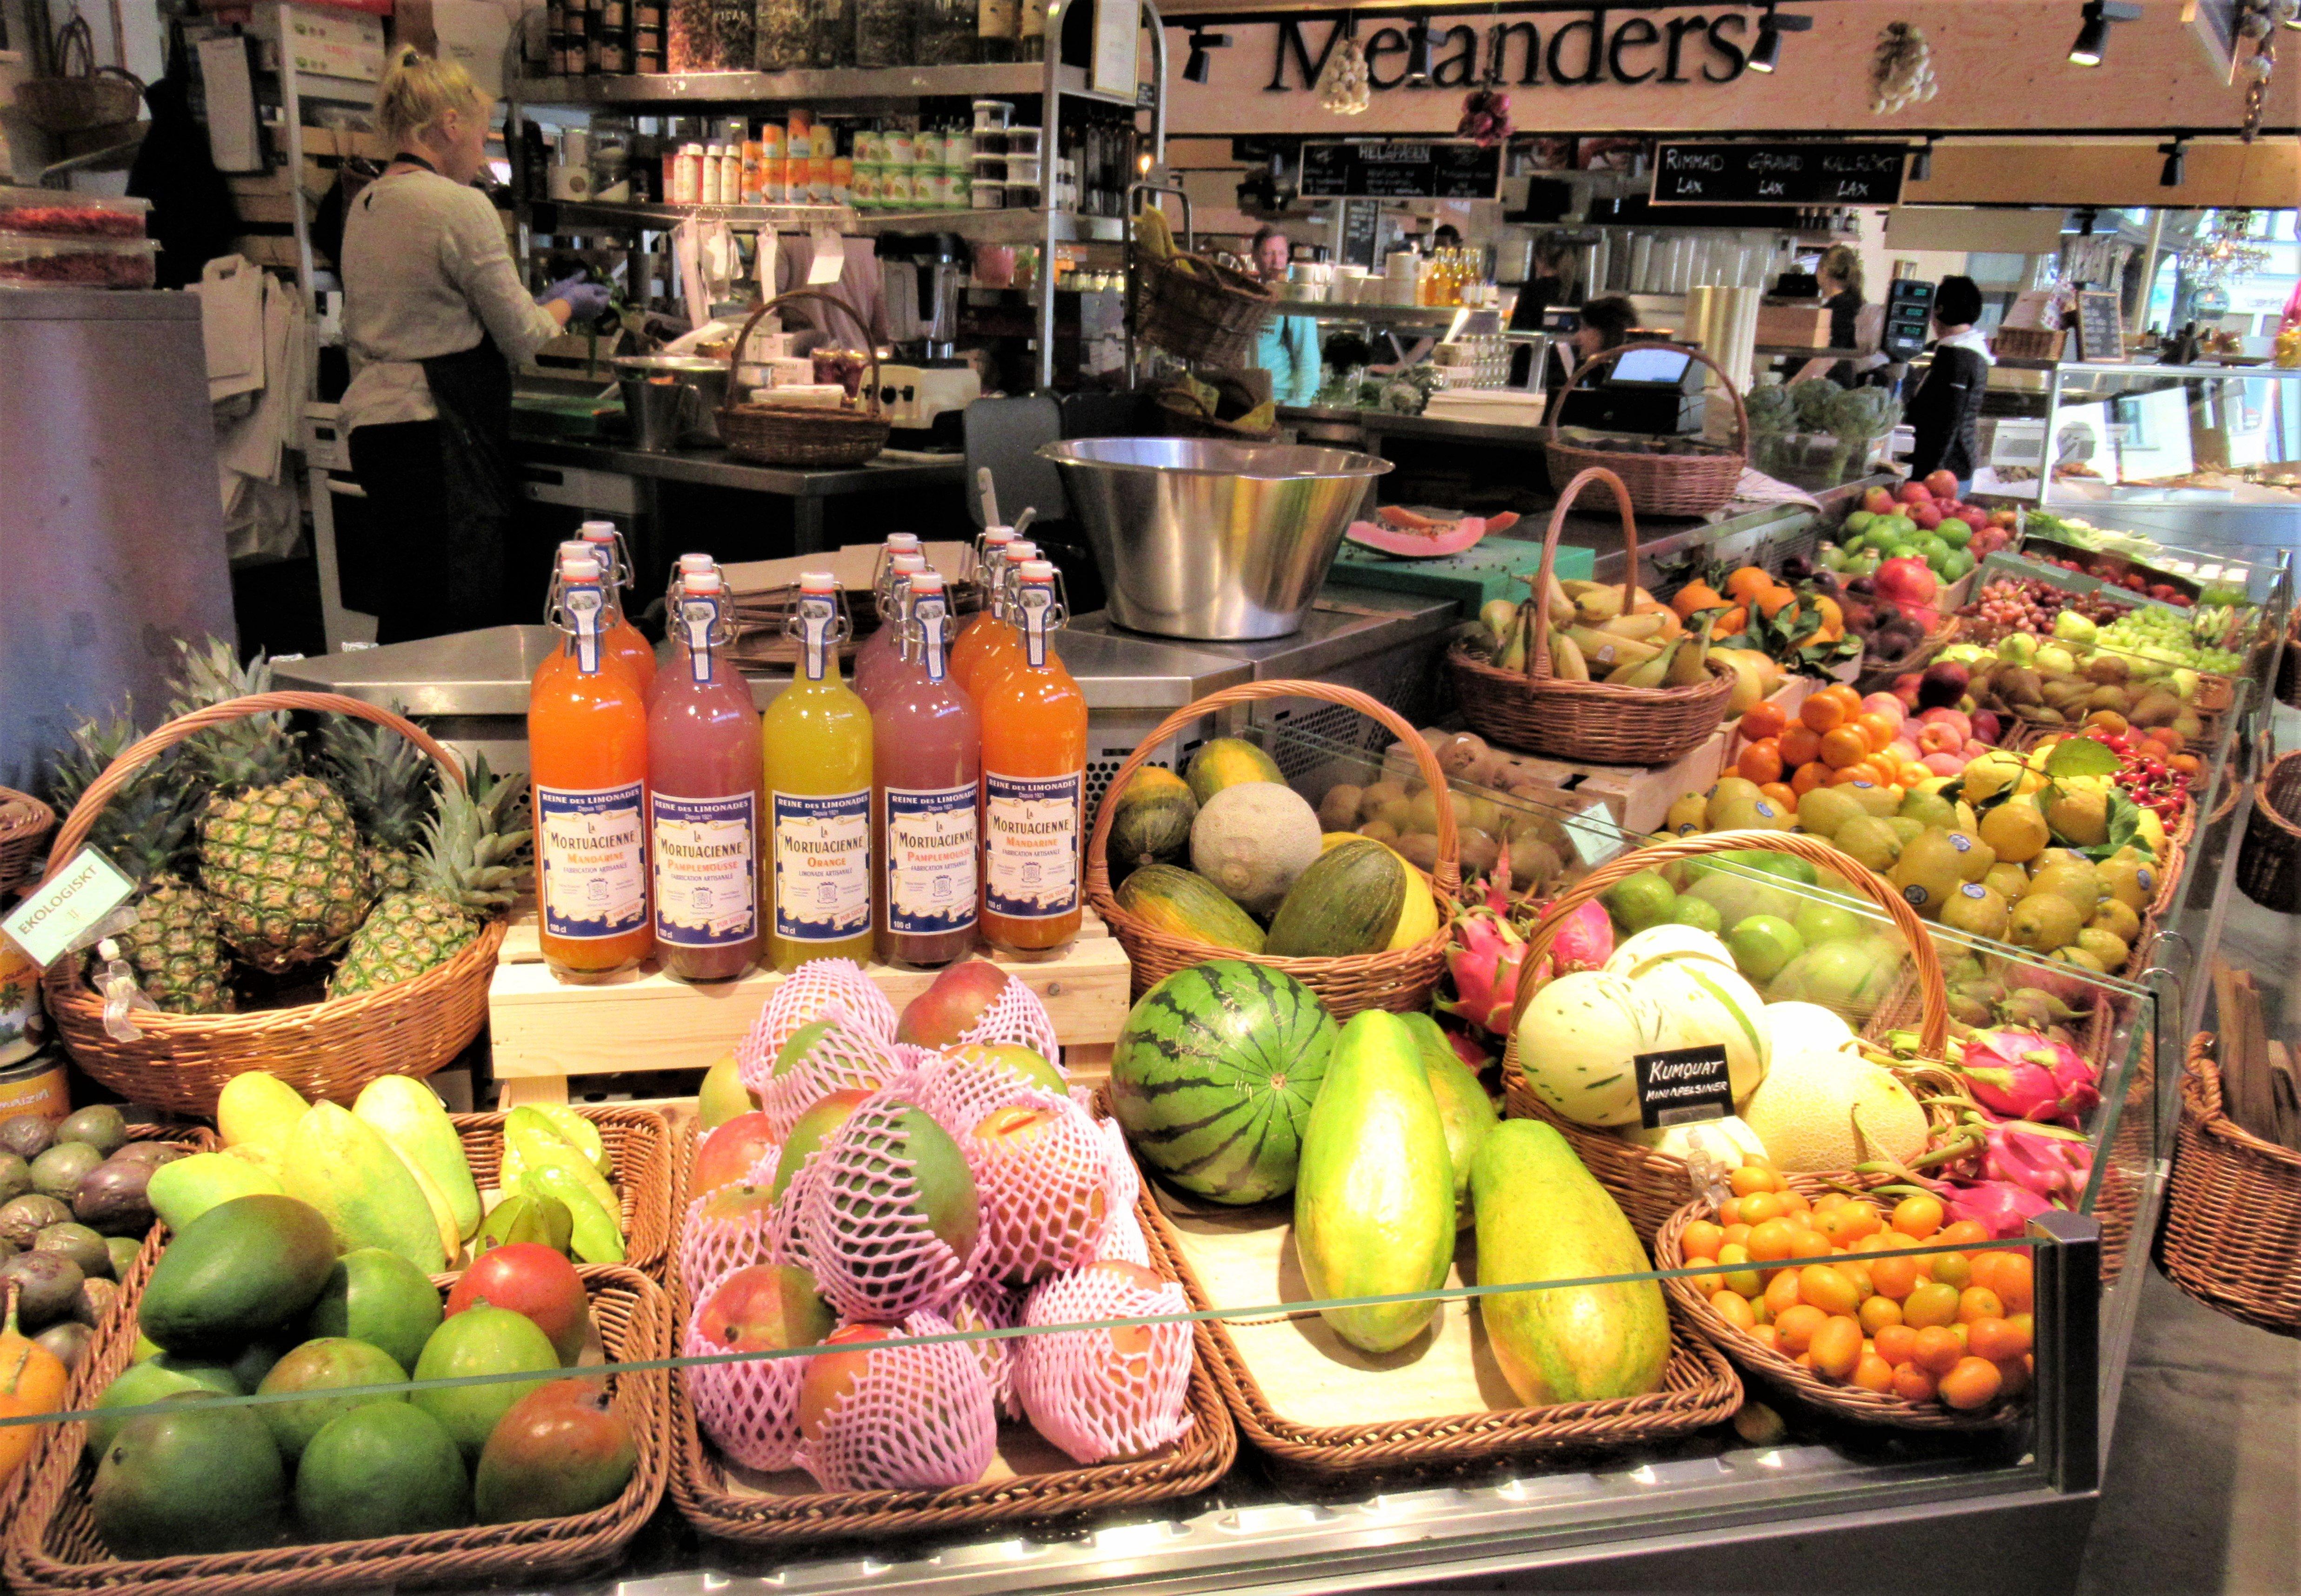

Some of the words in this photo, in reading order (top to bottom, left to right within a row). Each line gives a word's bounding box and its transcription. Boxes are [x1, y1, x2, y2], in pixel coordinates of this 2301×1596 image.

[1263, 9, 1748, 92] Meanders
[1676, 177, 1702, 194] LAX
[1758, 180, 1784, 195] LAX
[1837, 180, 1869, 197] LAX
[989, 779, 1009, 789] REINE
[1028, 779, 1075, 791] LIMONADES
[543, 794, 567, 803] REINE
[570, 795, 585, 804] DES
[588, 788, 639, 804] LIMONADES
[778, 798, 802, 808] REINE
[822, 795, 867, 808] LIMONADES
[893, 795, 917, 804] REINE
[655, 800, 675, 810] REINE
[694, 800, 748, 812] LIMONADES
[994, 815, 1068, 834] MORTUACIENNE
[551, 830, 634, 849] MORTUACIENNE
[785, 835, 863, 853] MORTUACIENNE
[900, 829, 973, 848] MORTUACIENNE
[1007, 836, 1057, 847] MANDARINE
[661, 839, 742, 858] MORTUACIENNE
[907, 848, 970, 861] PAMPLEMOUSSE
[568, 852, 623, 864] MANDARINE
[668, 860, 738, 872] PAMPLEMOUSSE
[808, 857, 846, 867] ORANGE
[18, 864, 98, 935] EKOLOGISKT
[1649, 1060, 1725, 1083] KUMQUAT
